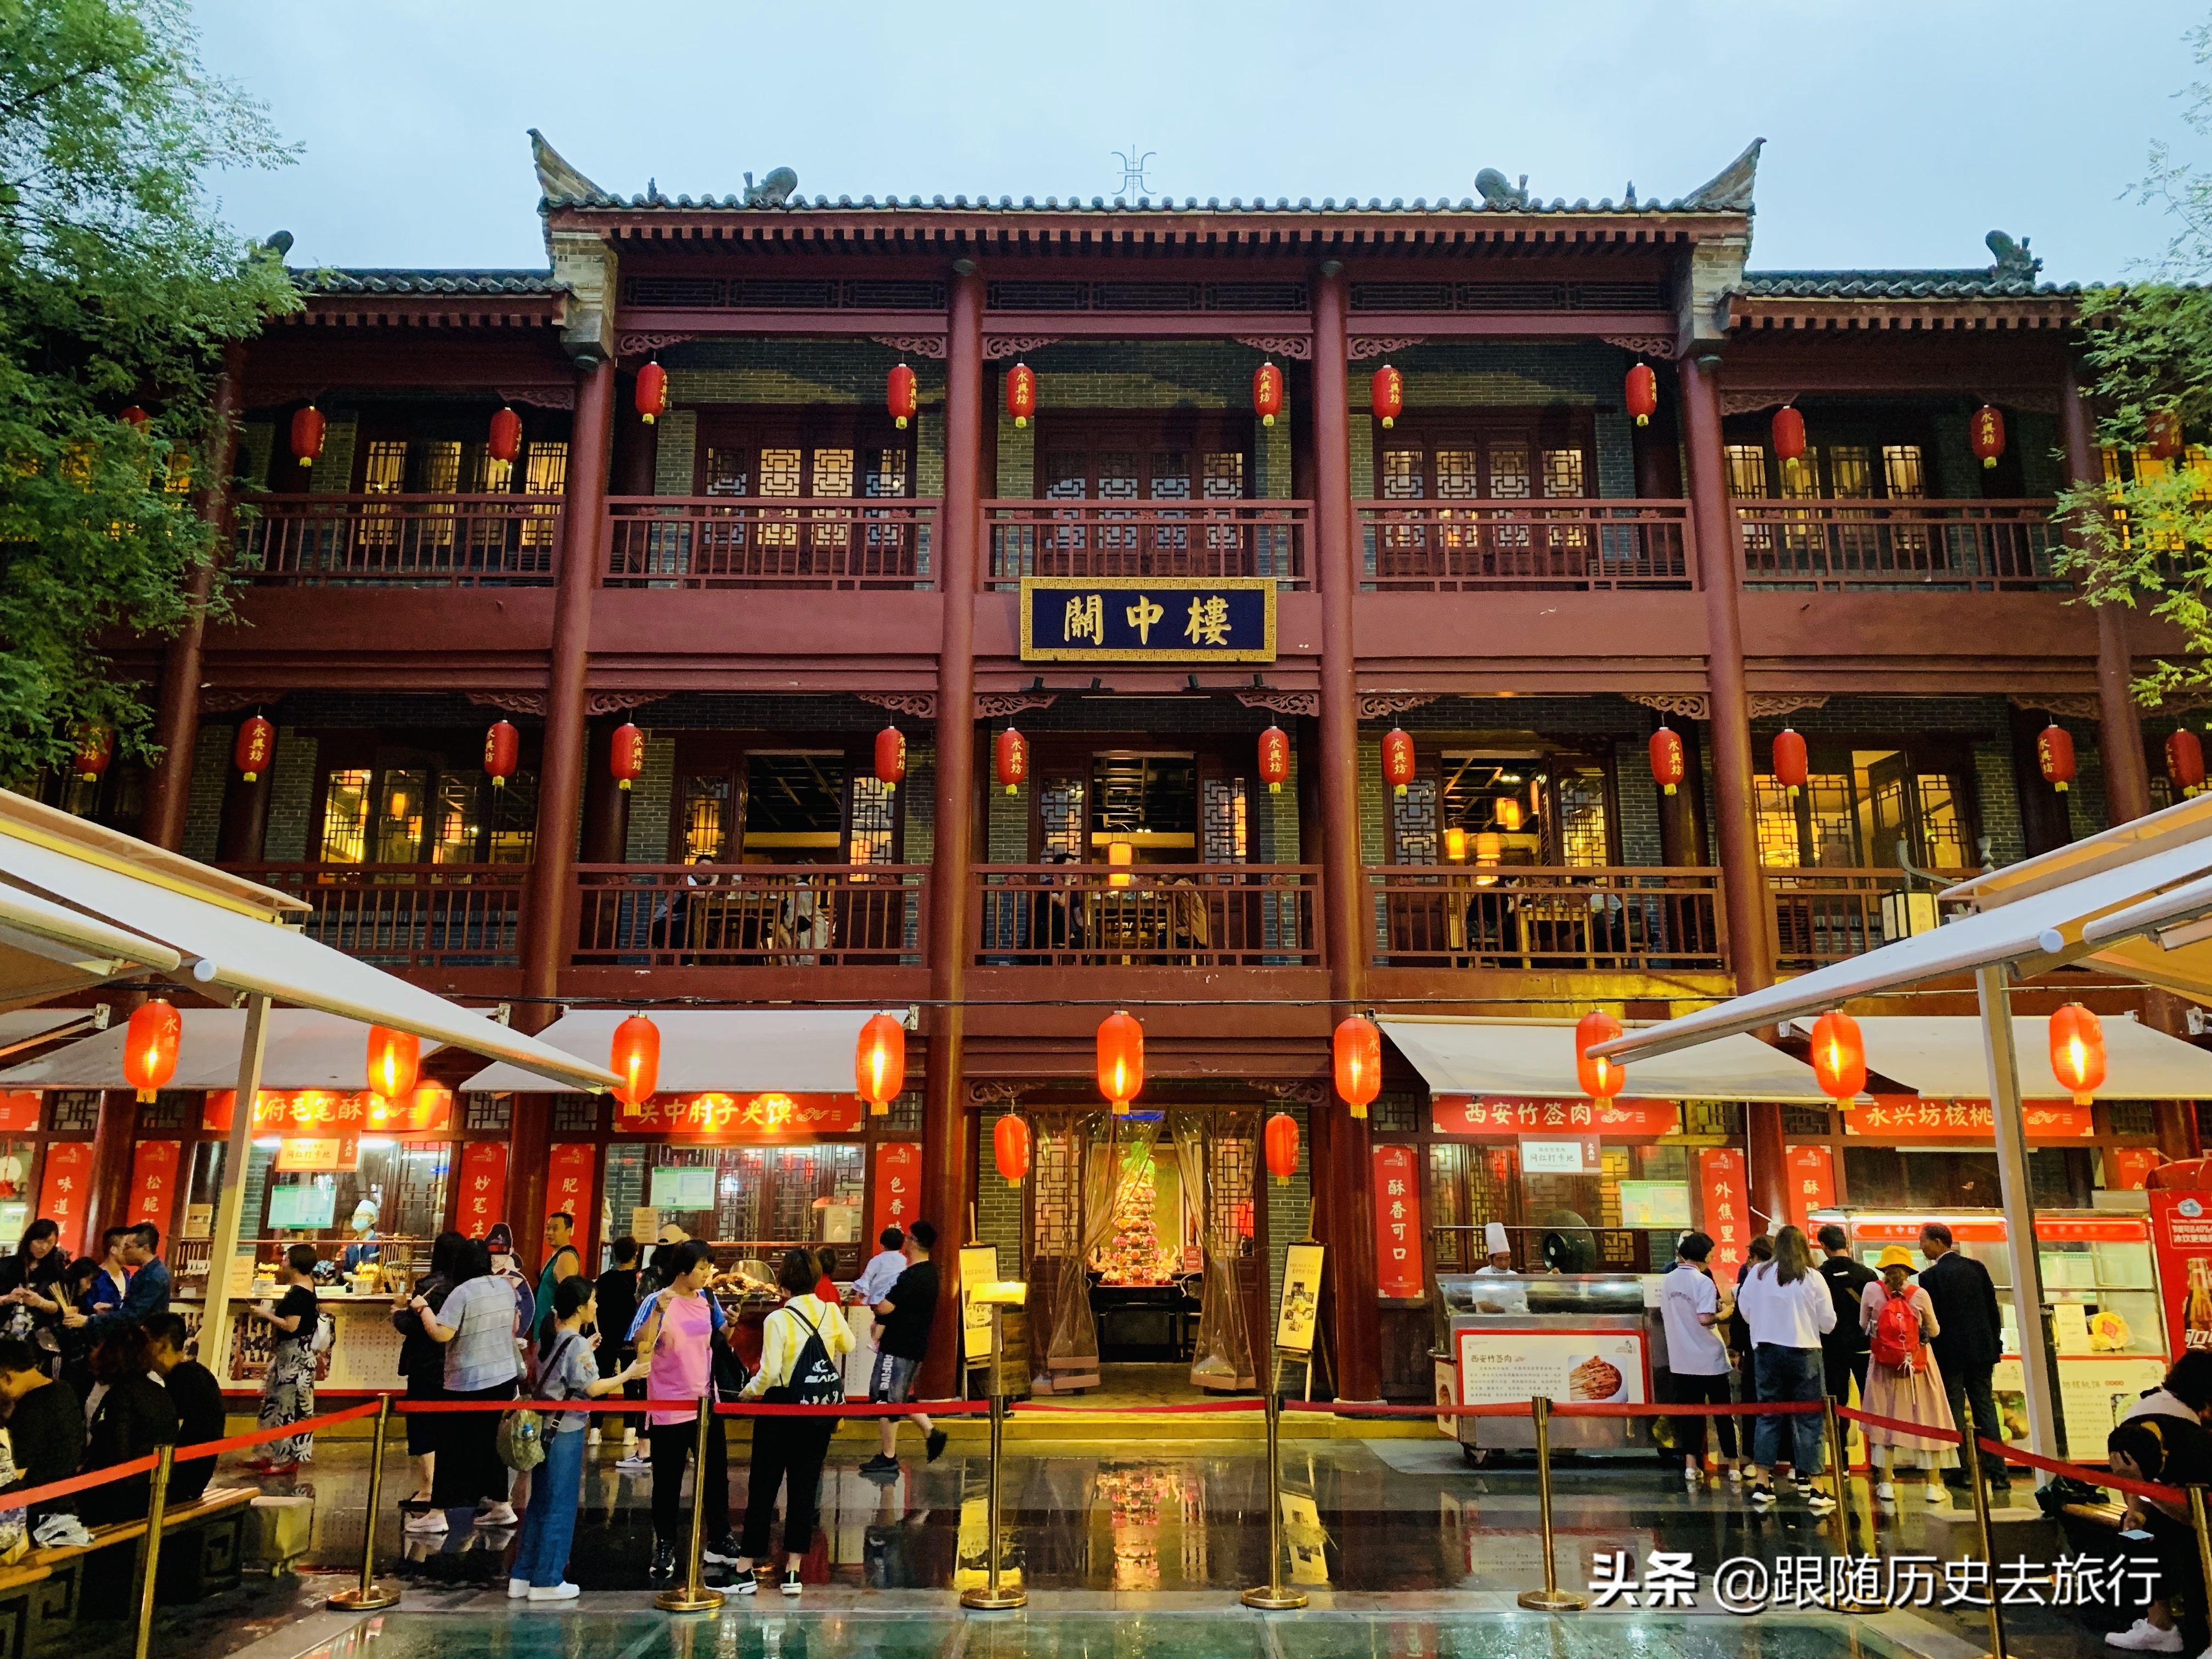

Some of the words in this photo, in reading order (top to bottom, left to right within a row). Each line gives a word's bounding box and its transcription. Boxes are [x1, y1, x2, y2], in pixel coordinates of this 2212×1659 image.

[908, 374, 917, 409] 永興坊
[1017, 370, 1029, 405] 永興坊
[1259, 369, 1272, 404] 永興坊
[1389, 370, 1400, 405] 永興坊
[1981, 412, 1995, 446] 永興坊
[1064, 594, 1232, 646] 關中樓
[249, 724, 266, 763] 永興坊
[485, 727, 495, 763] 永興坊
[632, 732, 643, 771] 永興坊
[896, 733, 906, 771] 永興坊
[1009, 736, 1023, 774] 永興坊
[1268, 736, 1283, 773] 永興坊
[1391, 738, 1407, 775] 永興坊
[1669, 739, 1683, 776] 永興坊
[2039, 738, 2053, 774] 永興坊
[638, 1098, 792, 1125] 关中肘子夹馍
[1464, 1102, 1592, 1126] 西安竹签肉
[286, 1150, 331, 1159] 网红打卡地
[1530, 1153, 1575, 1162] 网红打卡地
[142, 1174, 162, 1224] 松脆
[470, 1175, 491, 1239] 妙笔生
[558, 1177, 579, 1237] 肥瘦
[1388, 1179, 1407, 1260] 酥香可口
[1715, 1181, 1740, 1264] 外焦里嫩
[2185, 1329, 2212, 1350] 可口
[1470, 1355, 1513, 1363] 西安竹签肉
